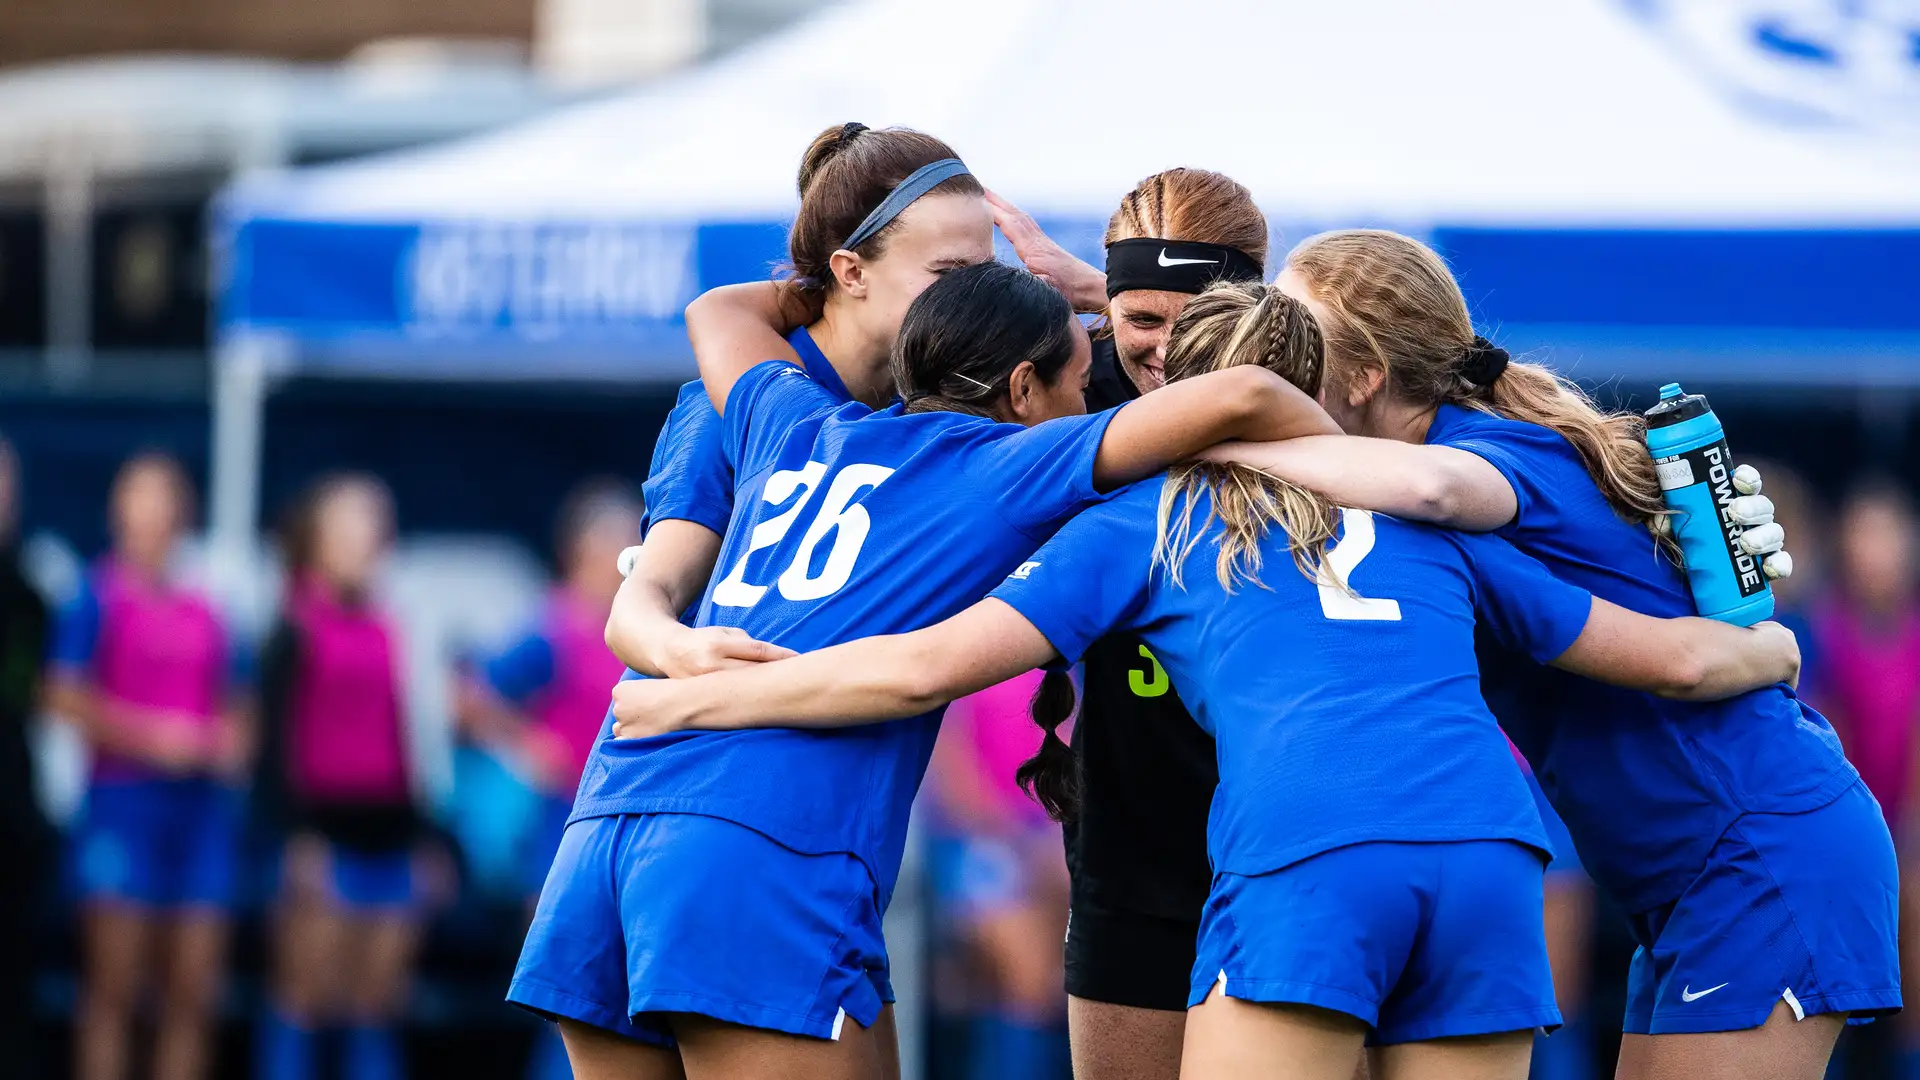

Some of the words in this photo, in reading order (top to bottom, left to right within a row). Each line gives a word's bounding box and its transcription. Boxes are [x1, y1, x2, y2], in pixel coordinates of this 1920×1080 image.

[712, 460, 896, 607] 26
[1316, 507, 1402, 621] 2
[1703, 446, 1761, 592] POWERADE
